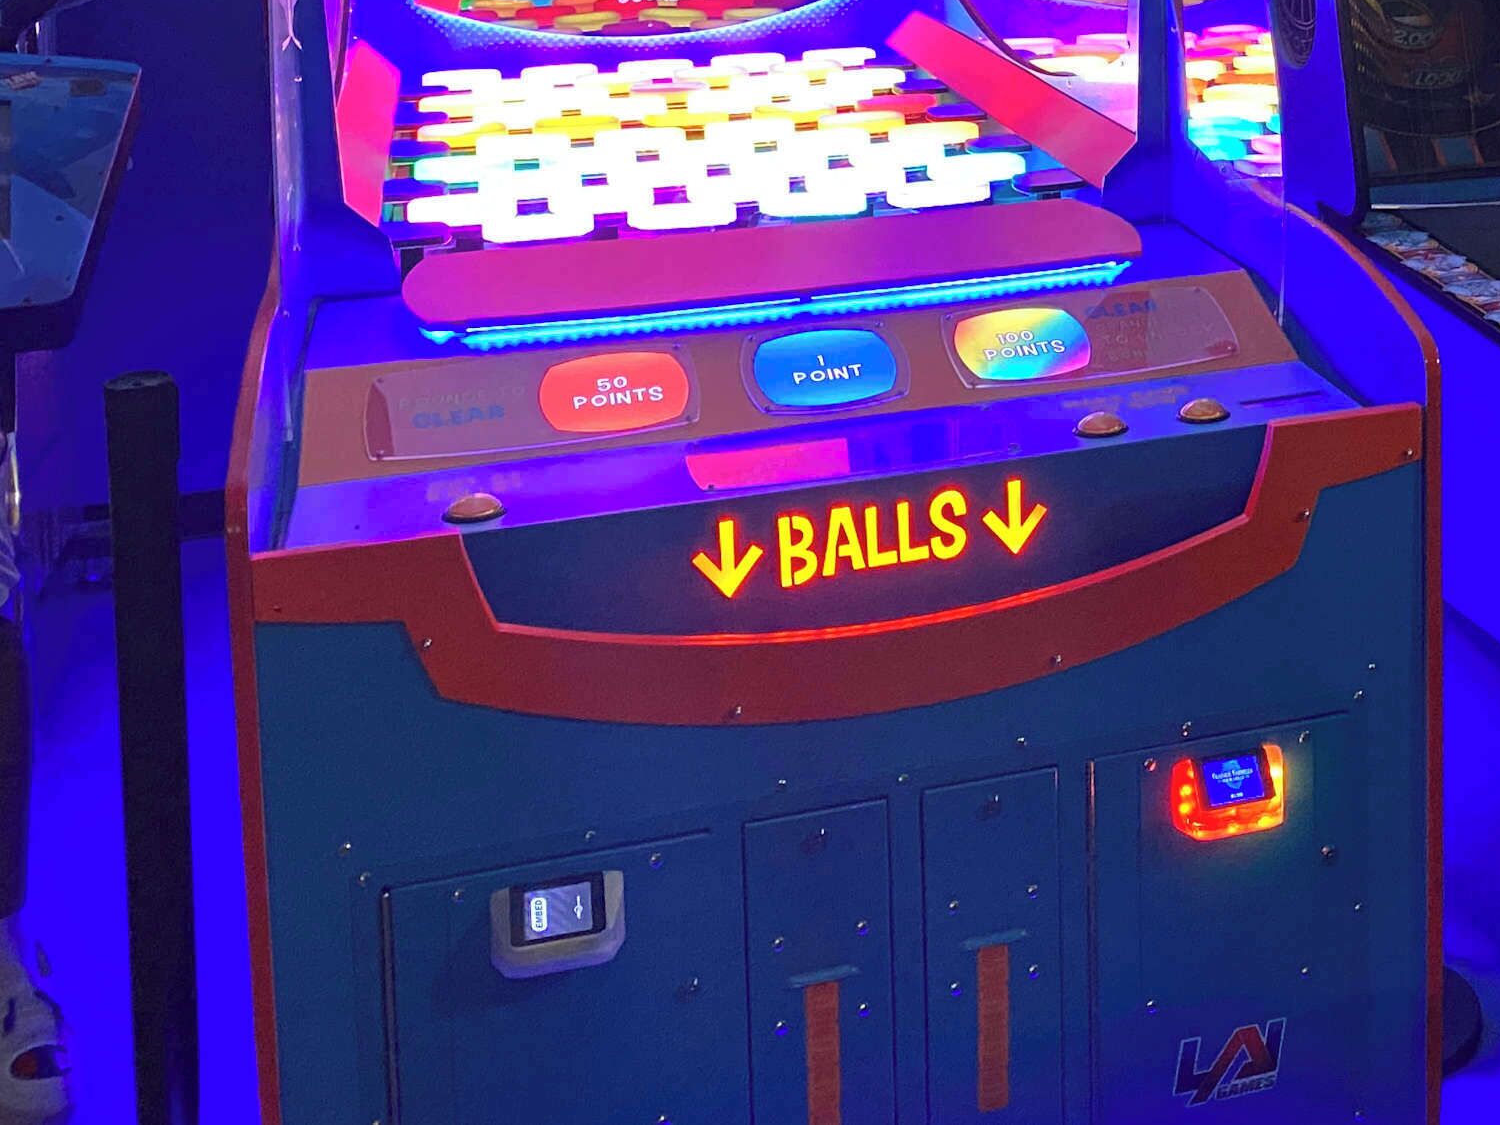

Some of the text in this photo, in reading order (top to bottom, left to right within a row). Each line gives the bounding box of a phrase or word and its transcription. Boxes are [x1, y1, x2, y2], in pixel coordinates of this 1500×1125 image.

[996, 329, 1035, 345] 100
[816, 354, 825, 367] 1
[983, 339, 1066, 362] POINTS
[596, 376, 628, 392] 50
[793, 363, 862, 386] POINT
[573, 386, 664, 409] POINTS
[777, 490, 968, 588] BALLS
[534, 899, 544, 929] EMBED
[1216, 1075, 1276, 1099] GAMES
